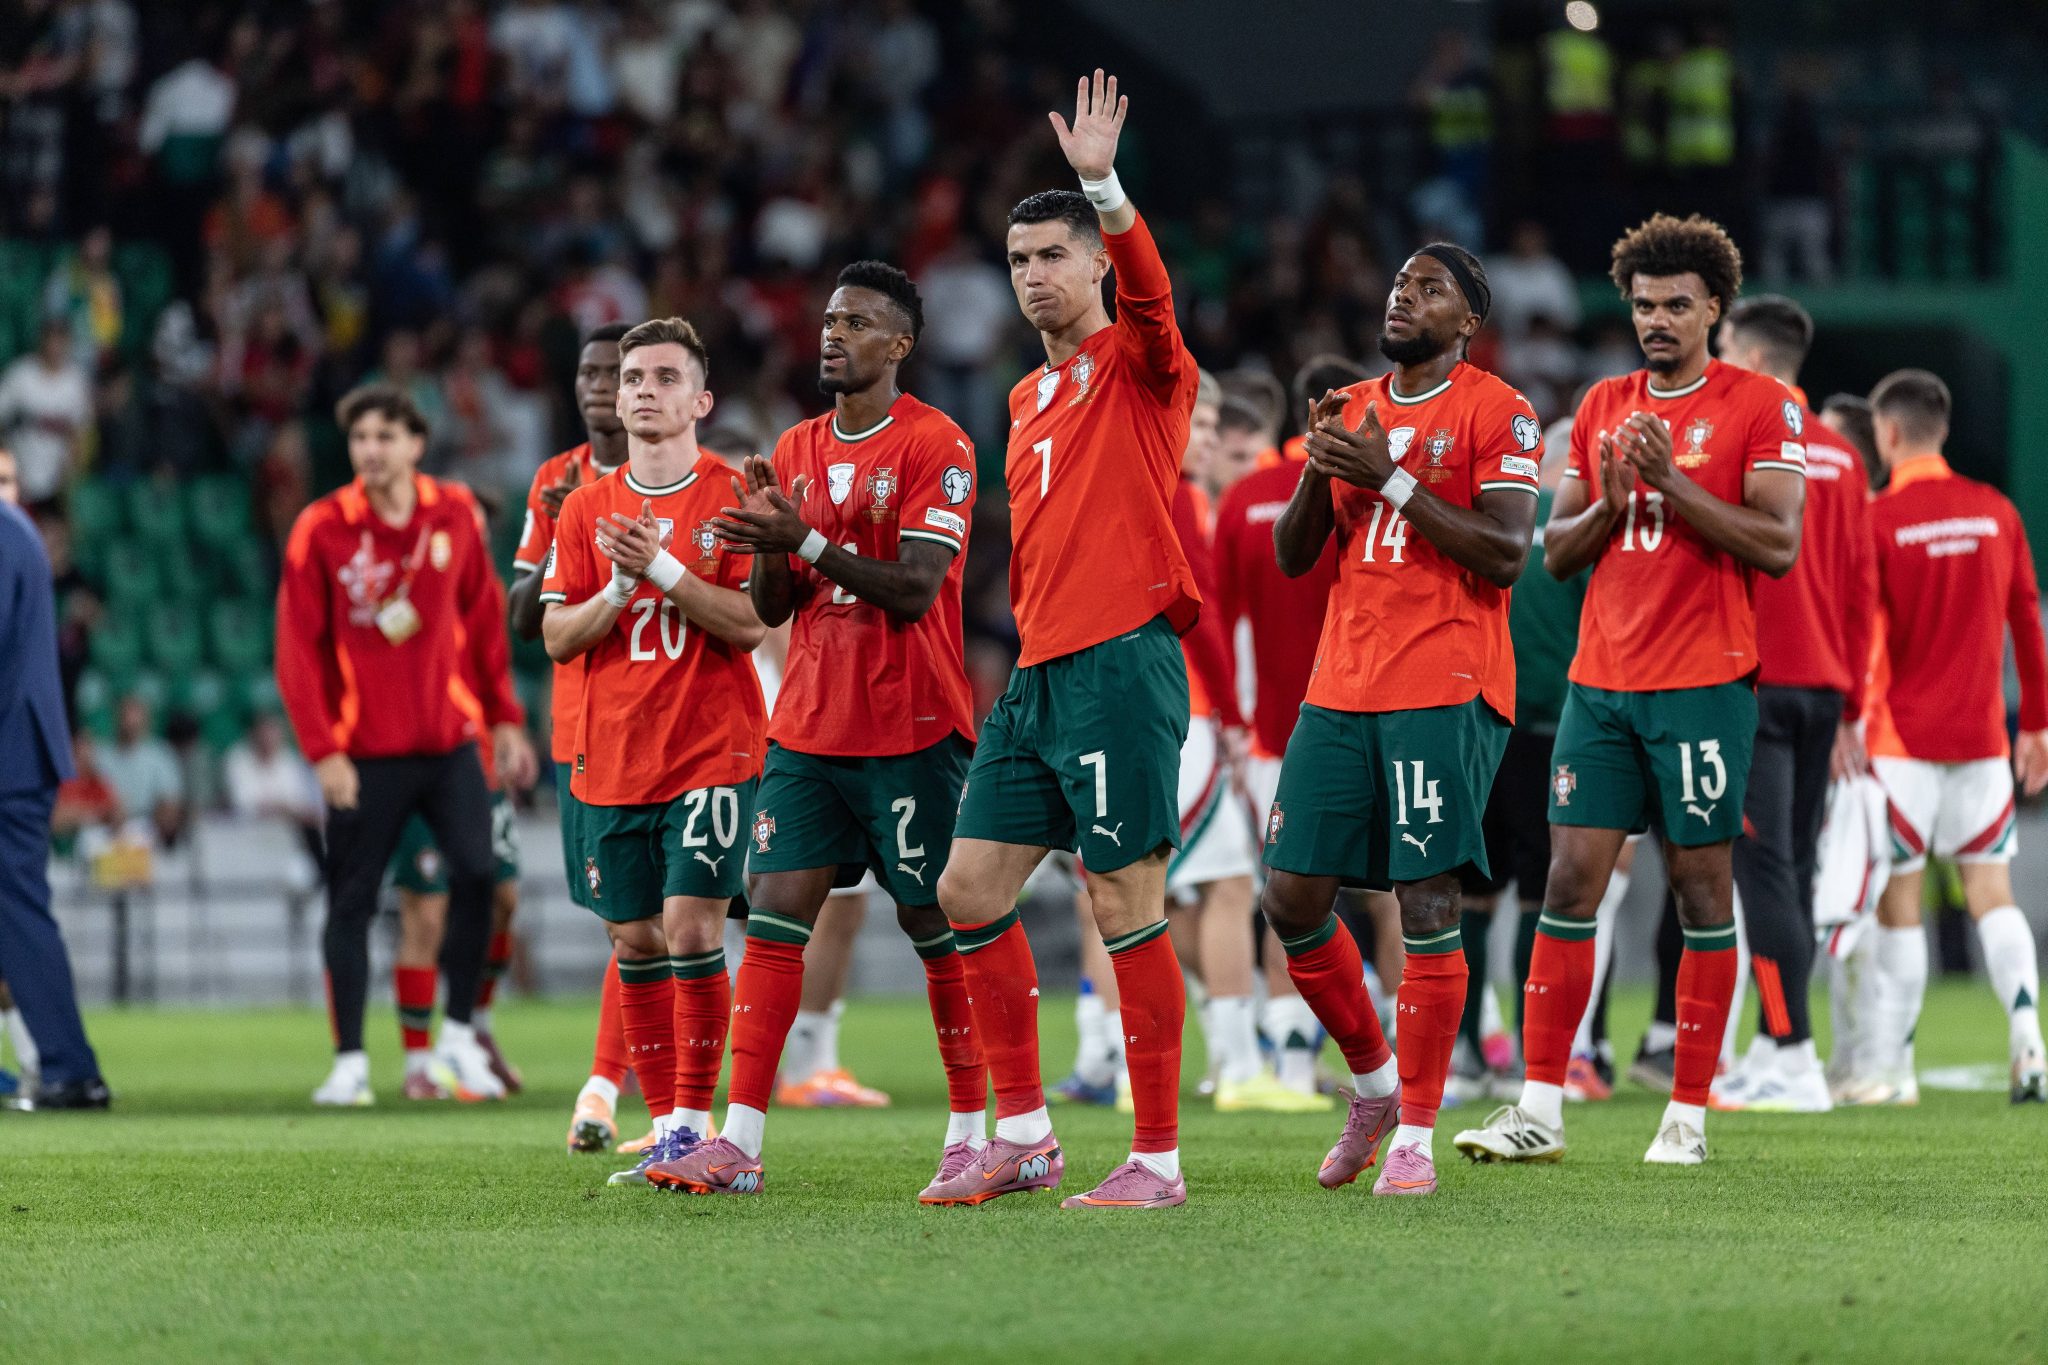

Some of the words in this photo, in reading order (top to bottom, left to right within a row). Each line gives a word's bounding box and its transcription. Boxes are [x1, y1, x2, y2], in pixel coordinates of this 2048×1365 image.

[1032, 436, 1053, 500] 7
[1361, 501, 1408, 563] 14
[1621, 490, 1664, 552] 13
[630, 598, 687, 661] 20
[1078, 750, 1107, 818] 7
[1392, 760, 1444, 825] 14
[1677, 738, 1727, 802] 13
[682, 787, 739, 849] 20
[891, 795, 925, 858] 2
